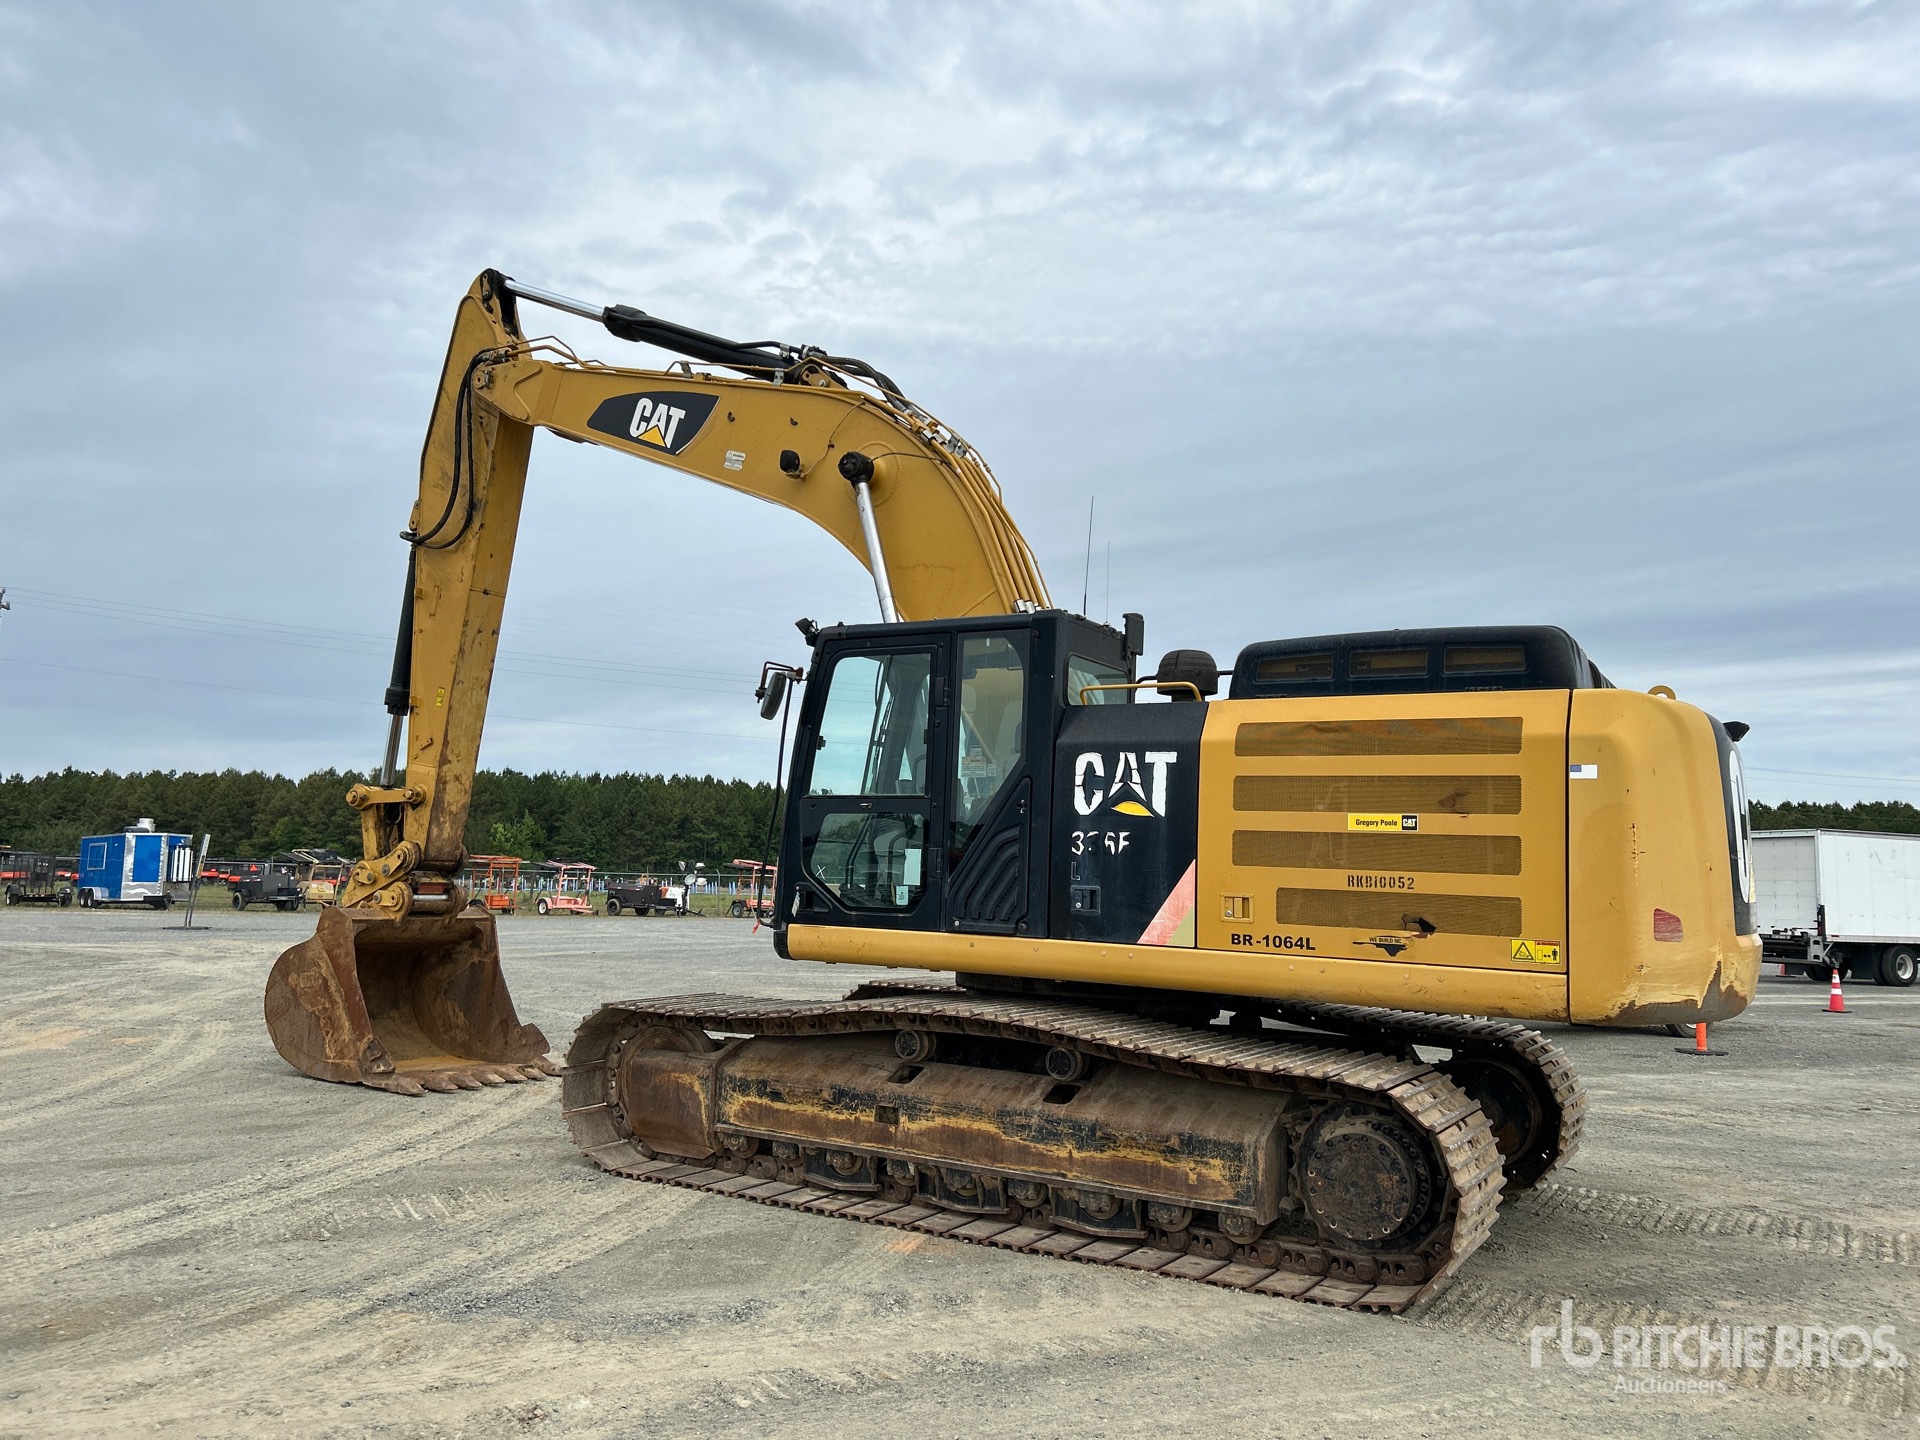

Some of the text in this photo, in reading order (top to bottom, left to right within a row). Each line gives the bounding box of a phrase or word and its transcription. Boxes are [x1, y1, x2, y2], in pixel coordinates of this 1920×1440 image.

[629, 397, 686, 449] CAT
[1073, 751, 1178, 818] CAT
[1355, 818, 1417, 828] Gregory Poole CAT
[1231, 933, 1316, 951] BR-1064L
